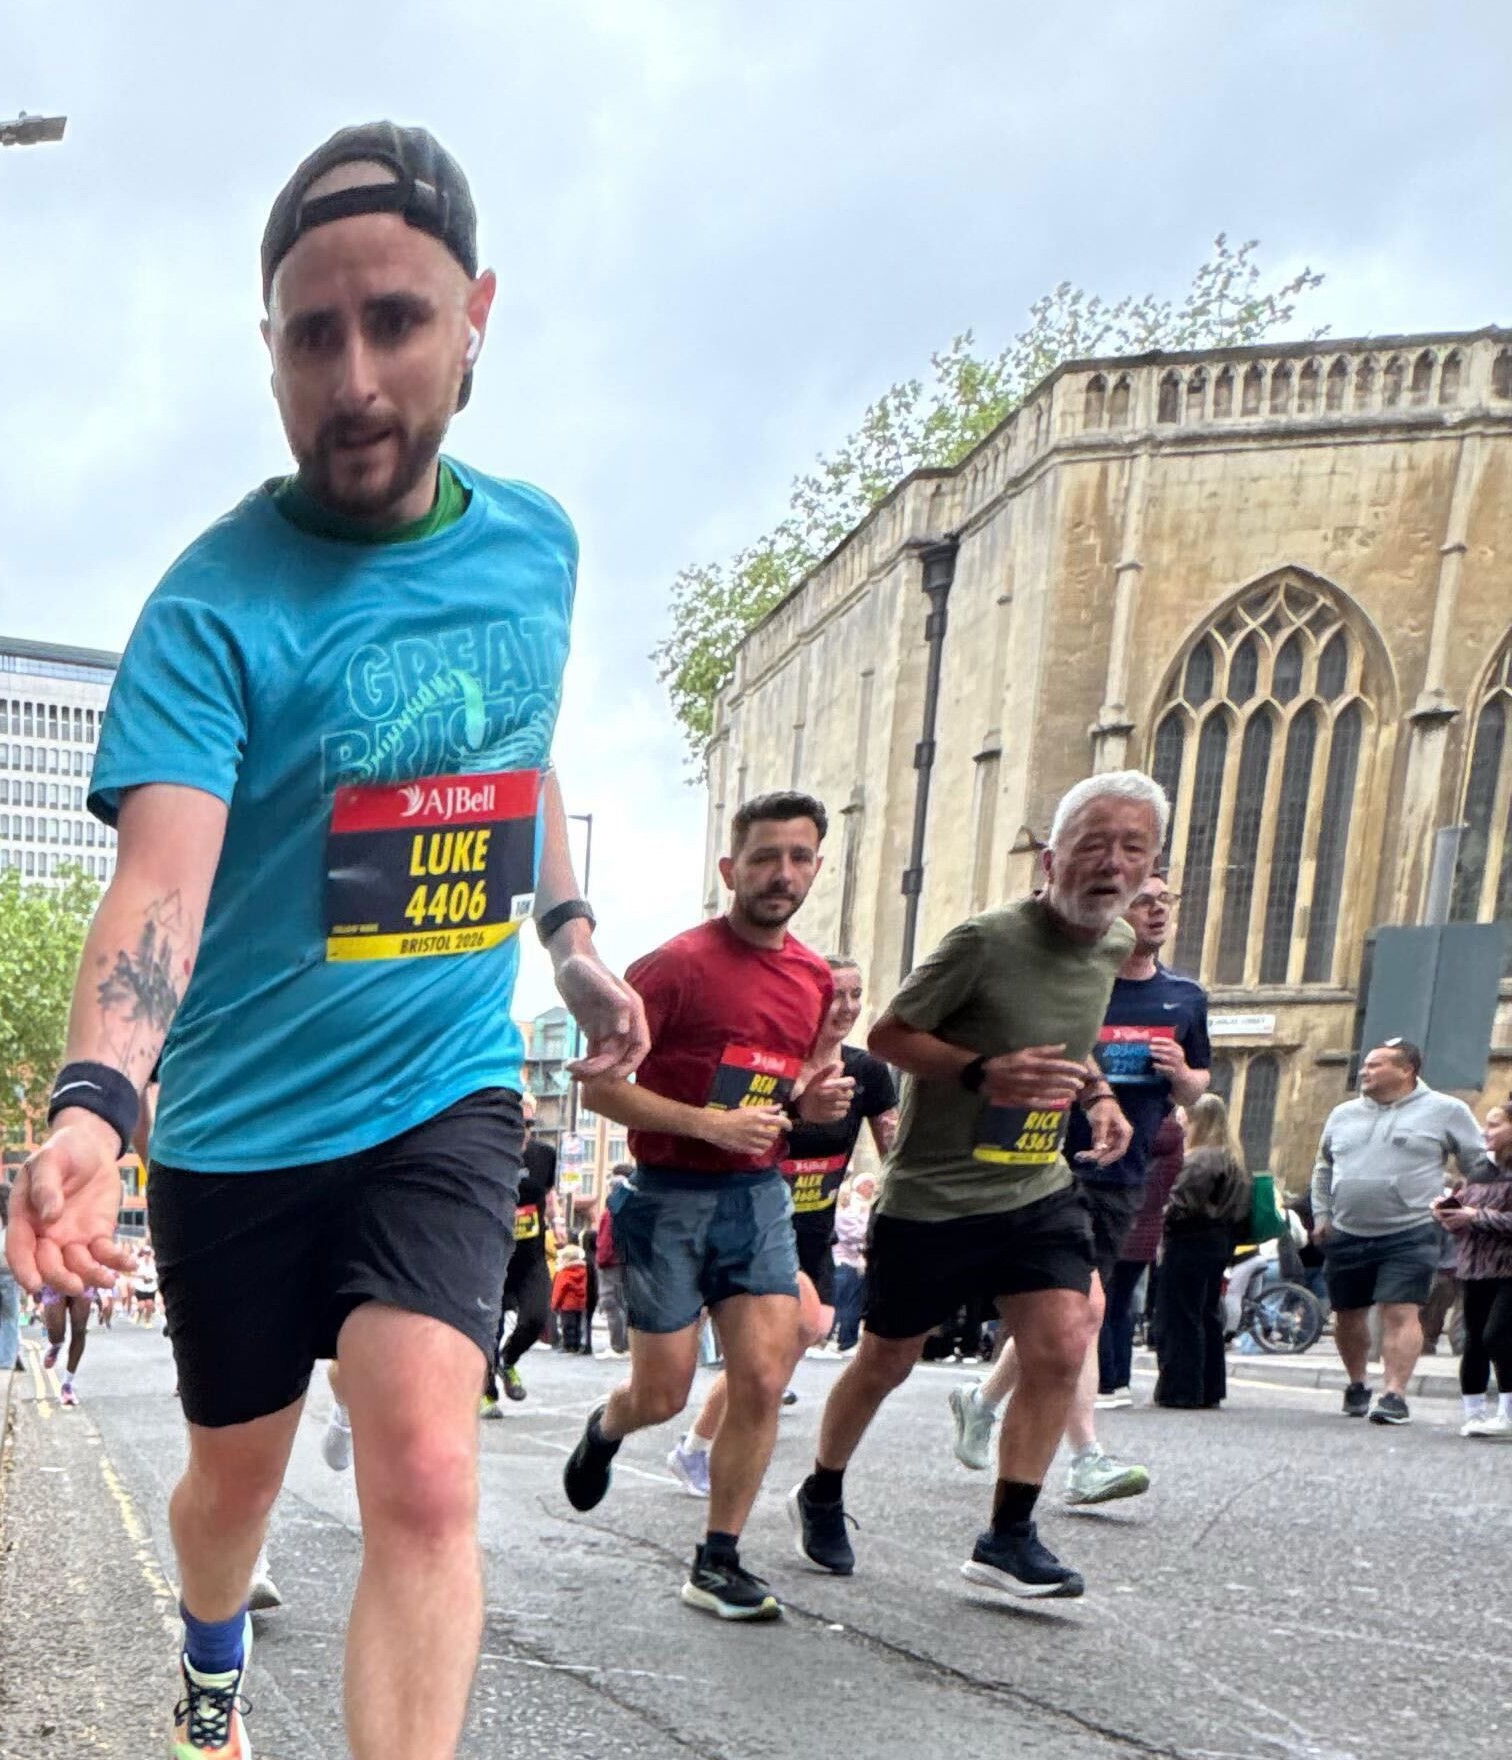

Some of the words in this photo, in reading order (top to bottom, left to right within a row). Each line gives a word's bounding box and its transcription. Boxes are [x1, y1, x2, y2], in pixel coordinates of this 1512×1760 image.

[347, 618, 559, 722] GREAT
[423, 785, 495, 820] AJBell
[410, 830, 490, 876] LUKE
[405, 880, 486, 926] 4406
[399, 935, 451, 954] BRISTOL
[455, 931, 485, 949] 2026
[1022, 1111, 1063, 1130] RICK
[1015, 1132, 1058, 1151] 4365
